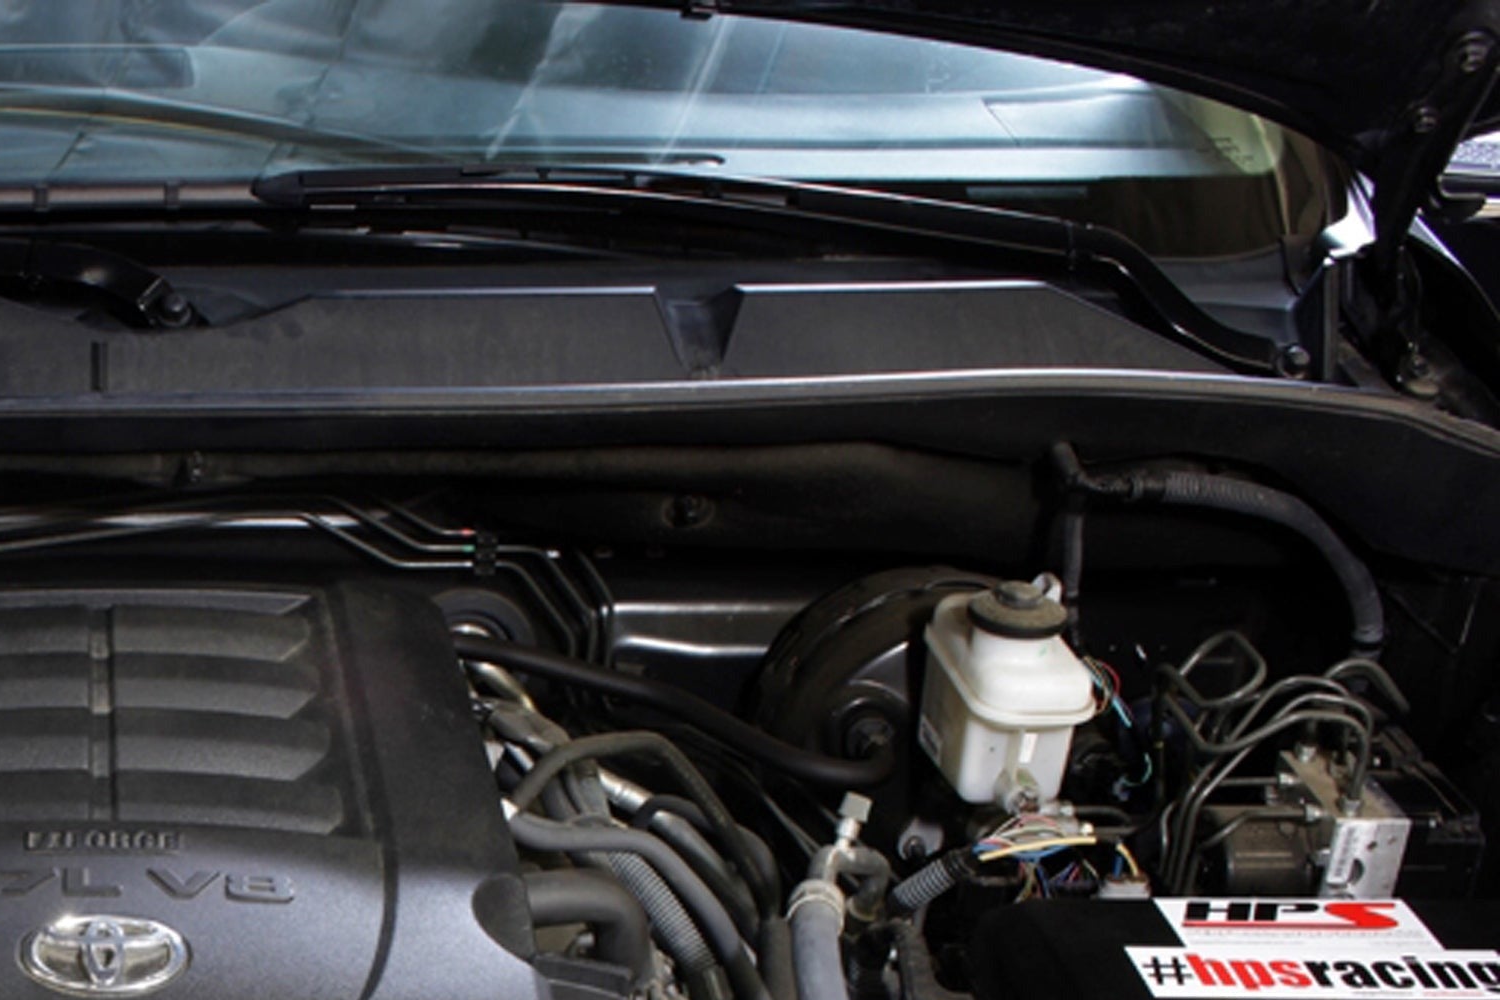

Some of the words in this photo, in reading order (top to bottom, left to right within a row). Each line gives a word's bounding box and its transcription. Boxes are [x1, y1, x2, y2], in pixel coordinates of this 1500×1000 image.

[146, 867, 296, 902] V8
[1182, 902, 1399, 928] HPS
[1142, 954, 1500, 993] #hpsracing
